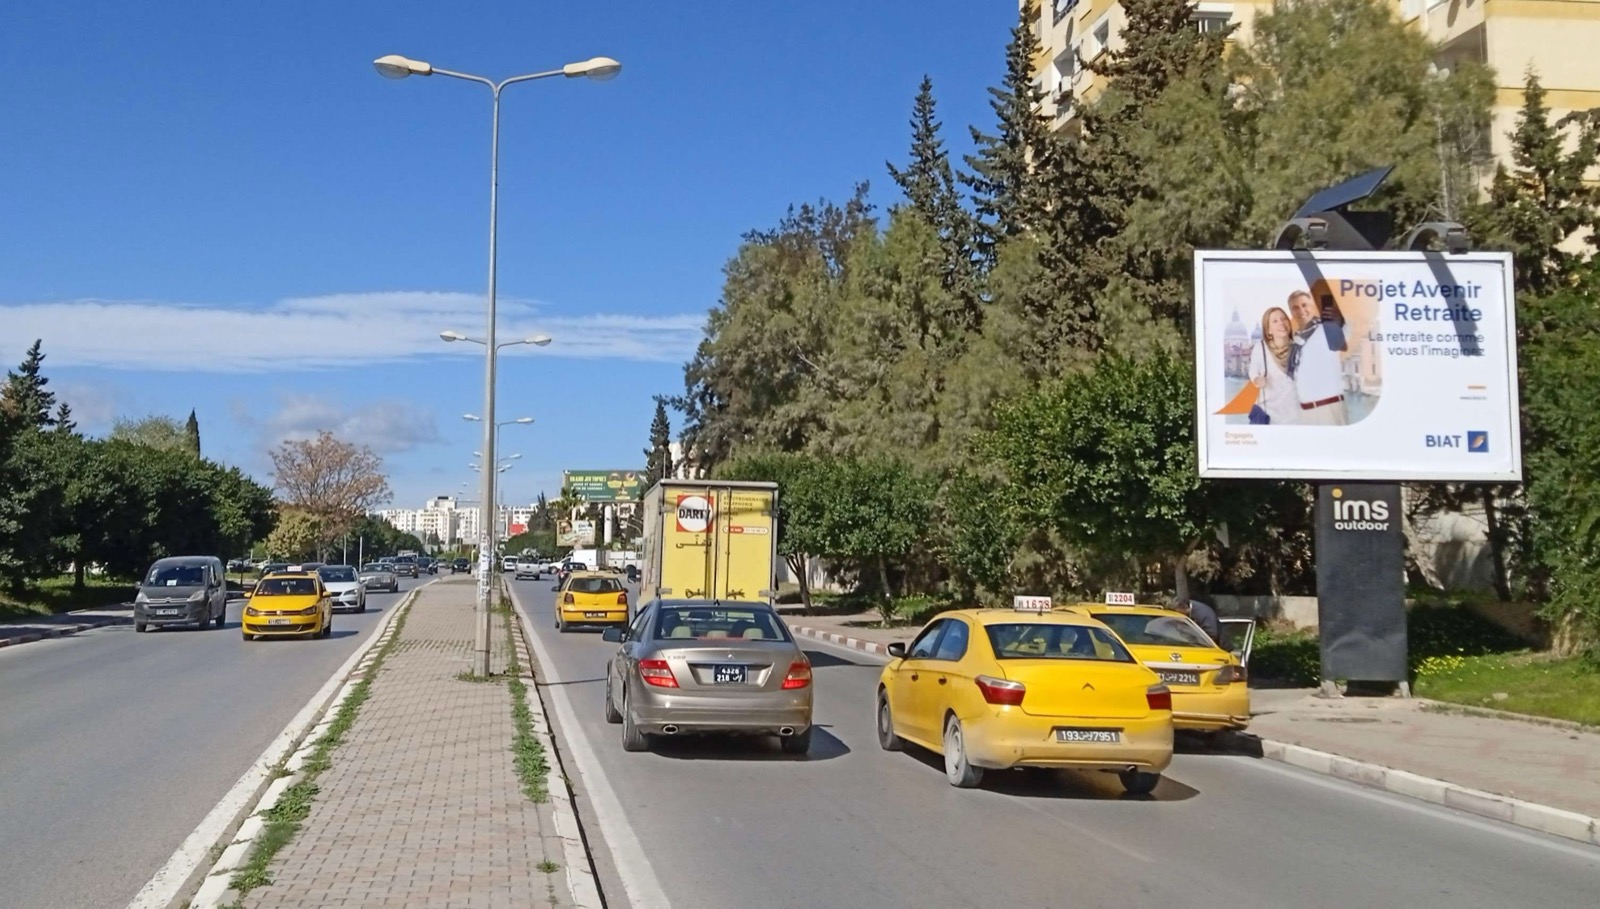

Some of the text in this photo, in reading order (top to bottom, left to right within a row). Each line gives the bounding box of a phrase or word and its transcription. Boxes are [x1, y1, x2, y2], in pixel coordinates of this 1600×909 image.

[1340, 279, 1482, 301] Projet Avenir
[1395, 303, 1482, 321] Retraite
[1368, 331, 1485, 343] La retraite comme
[1387, 345, 1485, 359] vous l'imaginez
[1425, 435, 1462, 448] BIAT
[1332, 488, 1389, 521] ims
[679, 509, 711, 520] DARTY
[1335, 521, 1389, 531] outdoor
[1114, 594, 1133, 602] 2204
[1178, 674, 1197, 683] 2214
[1062, 731, 1079, 740] 193
[1093, 732, 1116, 741] 7951
